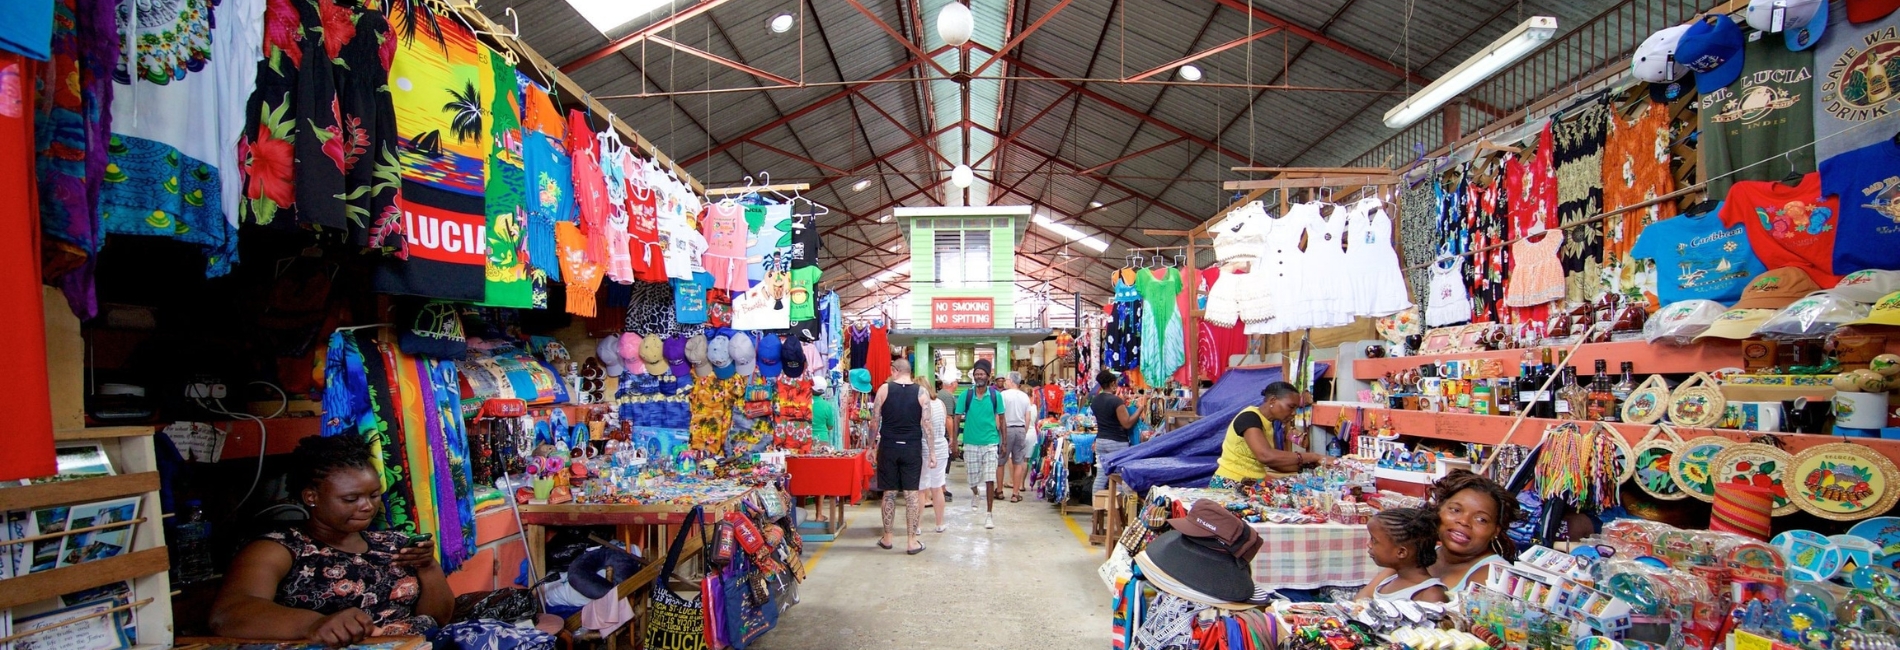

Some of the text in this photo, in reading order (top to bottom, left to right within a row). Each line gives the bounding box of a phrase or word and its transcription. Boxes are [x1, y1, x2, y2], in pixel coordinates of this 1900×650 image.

[1740, 66, 1812, 90] LUCIA
[1822, 46, 1859, 93] SAVE
[1826, 100, 1888, 121] DRINK
[404, 210, 486, 255] LUCIA
[1690, 227, 1743, 248] Caribbean
[935, 302, 990, 311] NO SMOKING
[935, 314, 990, 323] NO SPITTING
